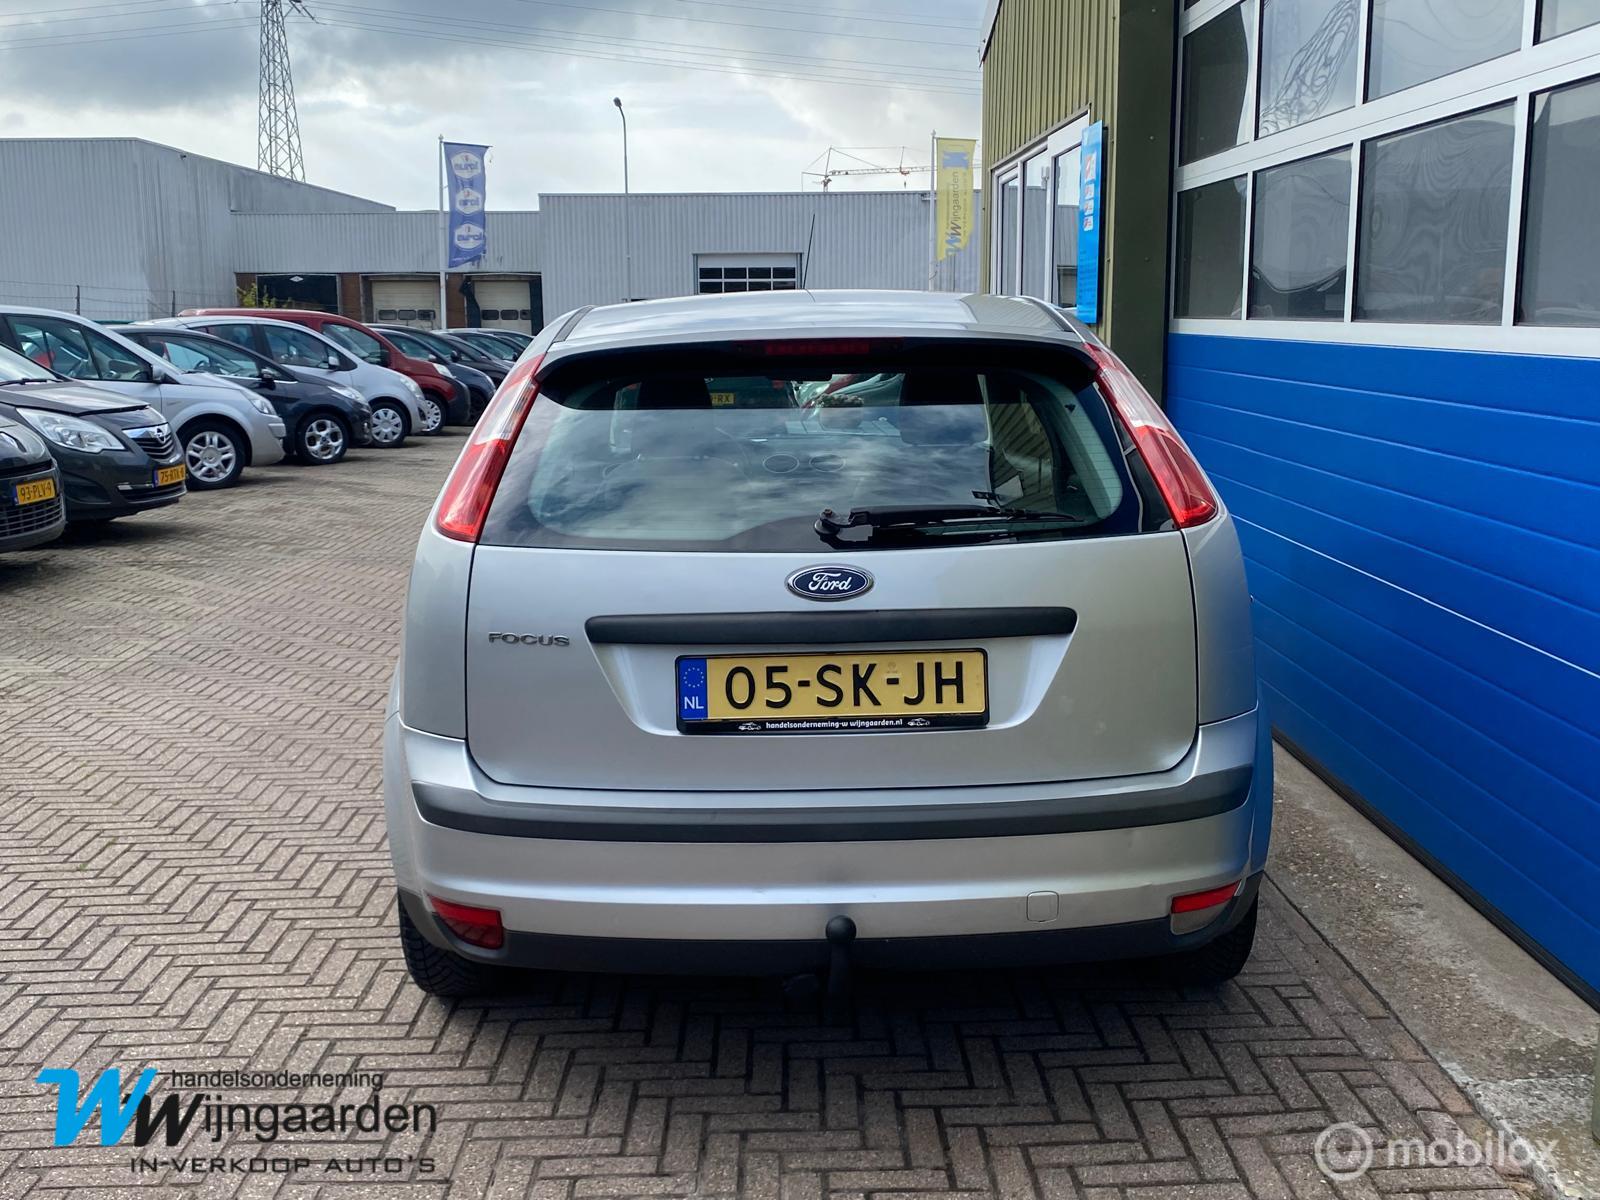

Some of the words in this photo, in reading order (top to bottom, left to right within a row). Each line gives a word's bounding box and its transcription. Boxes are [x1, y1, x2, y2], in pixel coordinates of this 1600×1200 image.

[20, 480, 52, 503] 93-PLV-9
[808, 572, 852, 591] Ford
[488, 631, 570, 647] FOCUS
[683, 696, 704, 710] NL
[725, 661, 965, 710] 05-SK-JH
[765, 720, 849, 730] handelsonderneming-w
[850, 718, 903, 728] wijngaarden.nl
